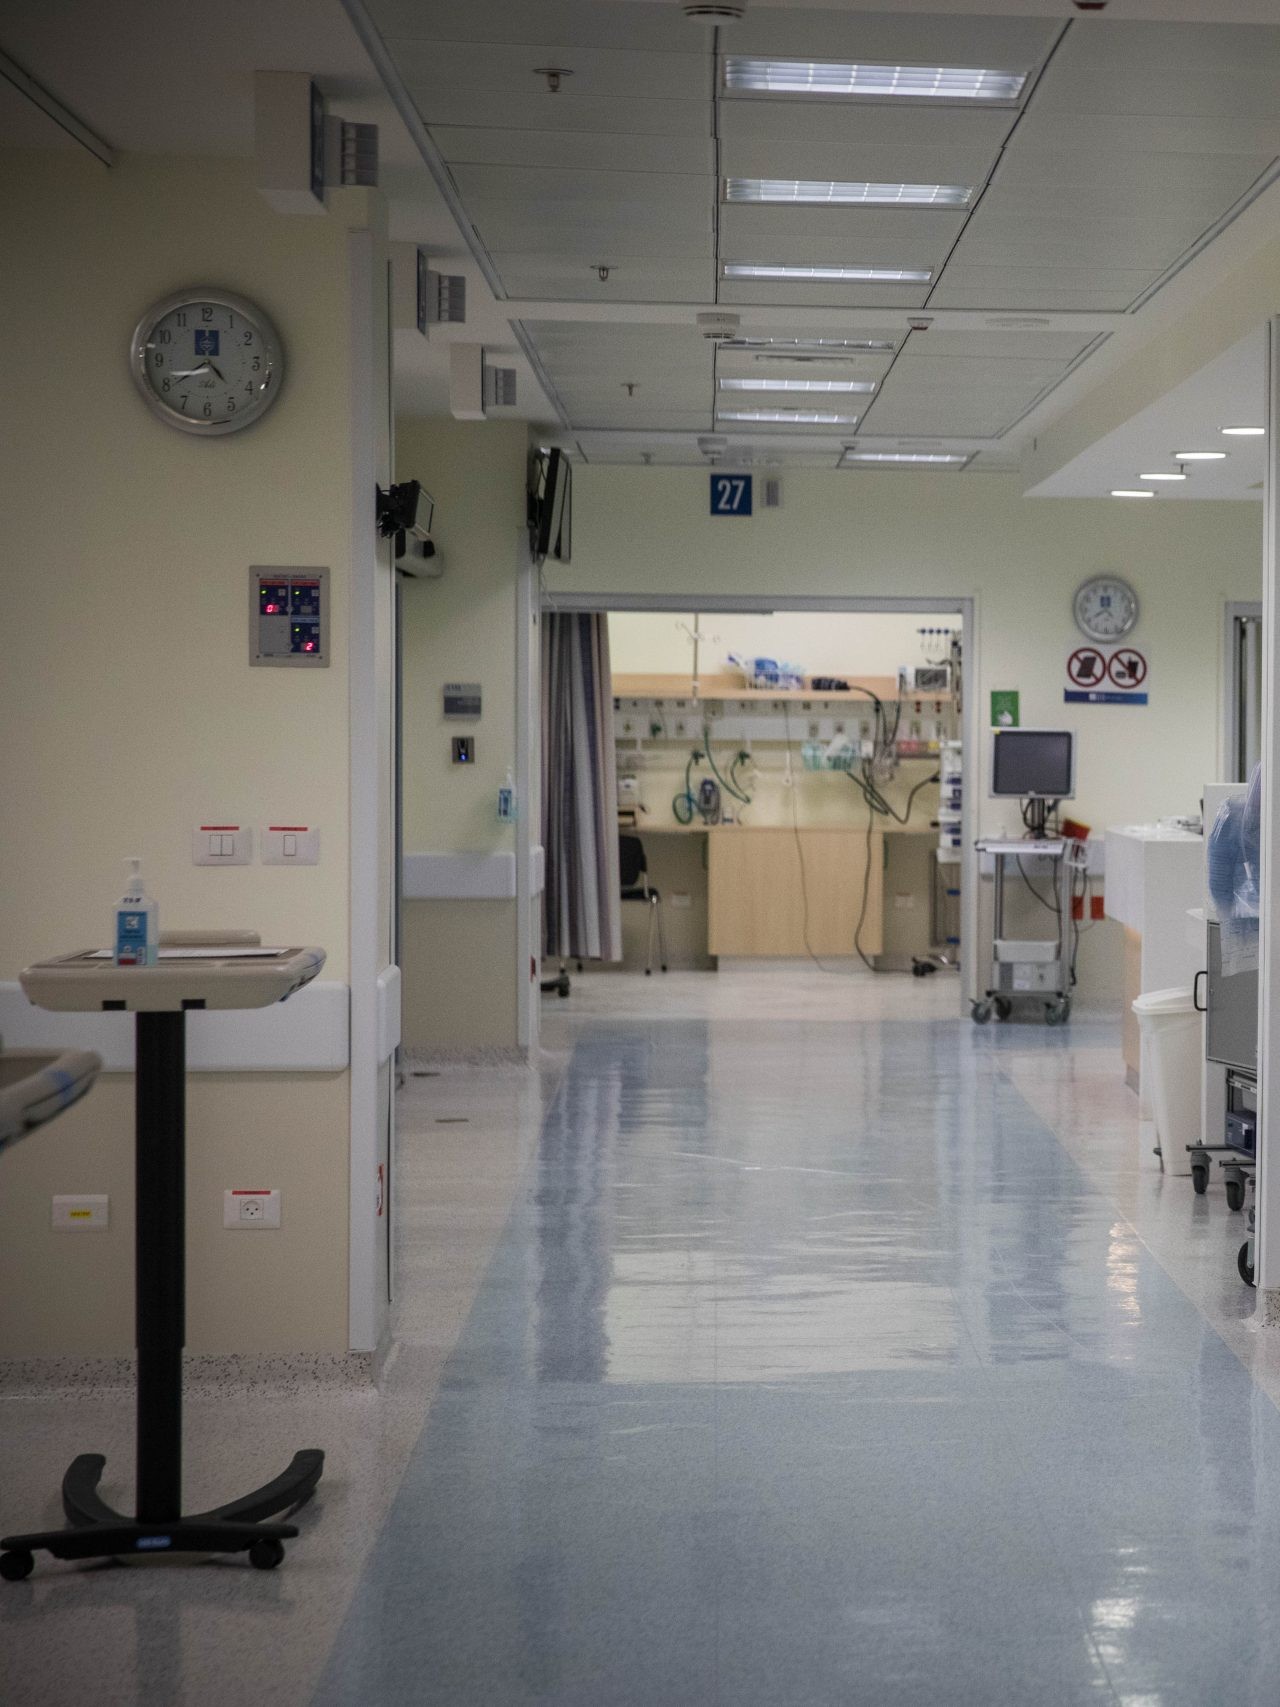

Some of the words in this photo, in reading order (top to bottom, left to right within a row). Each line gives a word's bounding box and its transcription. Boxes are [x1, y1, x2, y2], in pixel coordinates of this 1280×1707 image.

[176, 313, 187, 327] 11
[201, 307, 214, 322] 12
[229, 314, 234, 329] 1
[159, 329, 171, 345] 10
[244, 331, 253, 346] 2
[155, 352, 164, 368] 9
[251, 356, 260, 371] 3
[162, 377, 170, 392] 8
[244, 380, 253, 395] 4
[180, 395, 188, 410] 7
[203, 402, 212, 417] 6
[227, 396, 236, 412] 5
[717, 479, 745, 510] 27
